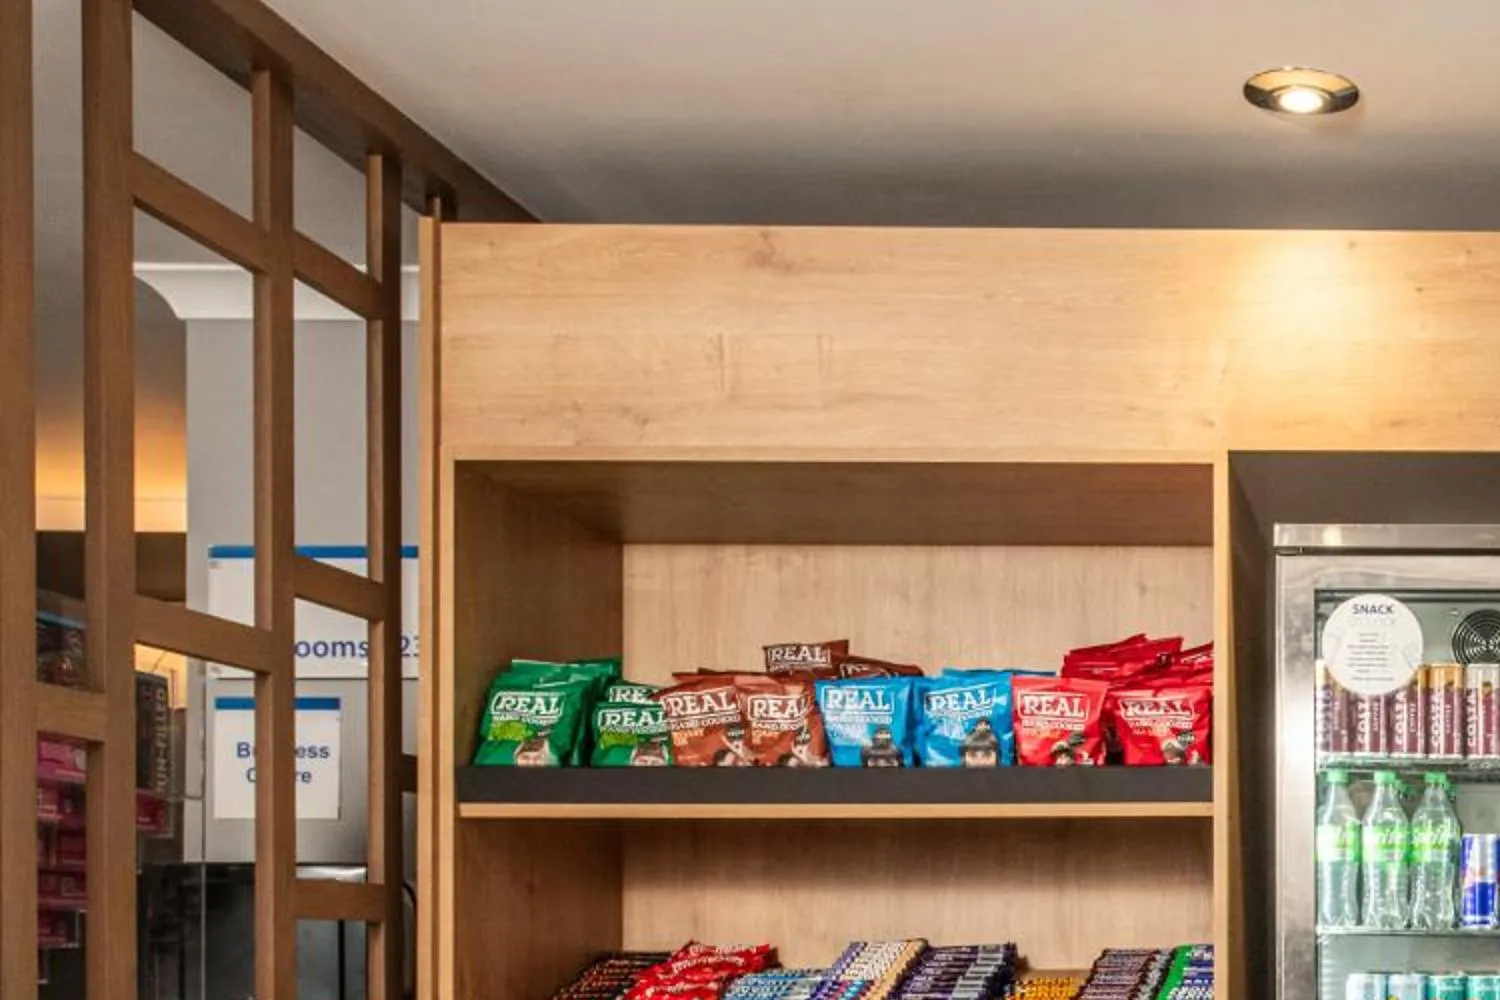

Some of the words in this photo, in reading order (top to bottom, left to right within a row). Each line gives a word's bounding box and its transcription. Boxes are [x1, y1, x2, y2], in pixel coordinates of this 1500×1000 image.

[1353, 604, 1394, 615] SNACK
[294, 640, 369, 658] ooms
[771, 646, 827, 663] REAL
[497, 696, 560, 714] REAL
[668, 691, 737, 717] REAL
[826, 687, 891, 711] REAL
[929, 689, 992, 713] REAL
[1023, 695, 1085, 718] REAL
[1125, 700, 1192, 717] REAL
[237, 741, 331, 759] Bess
